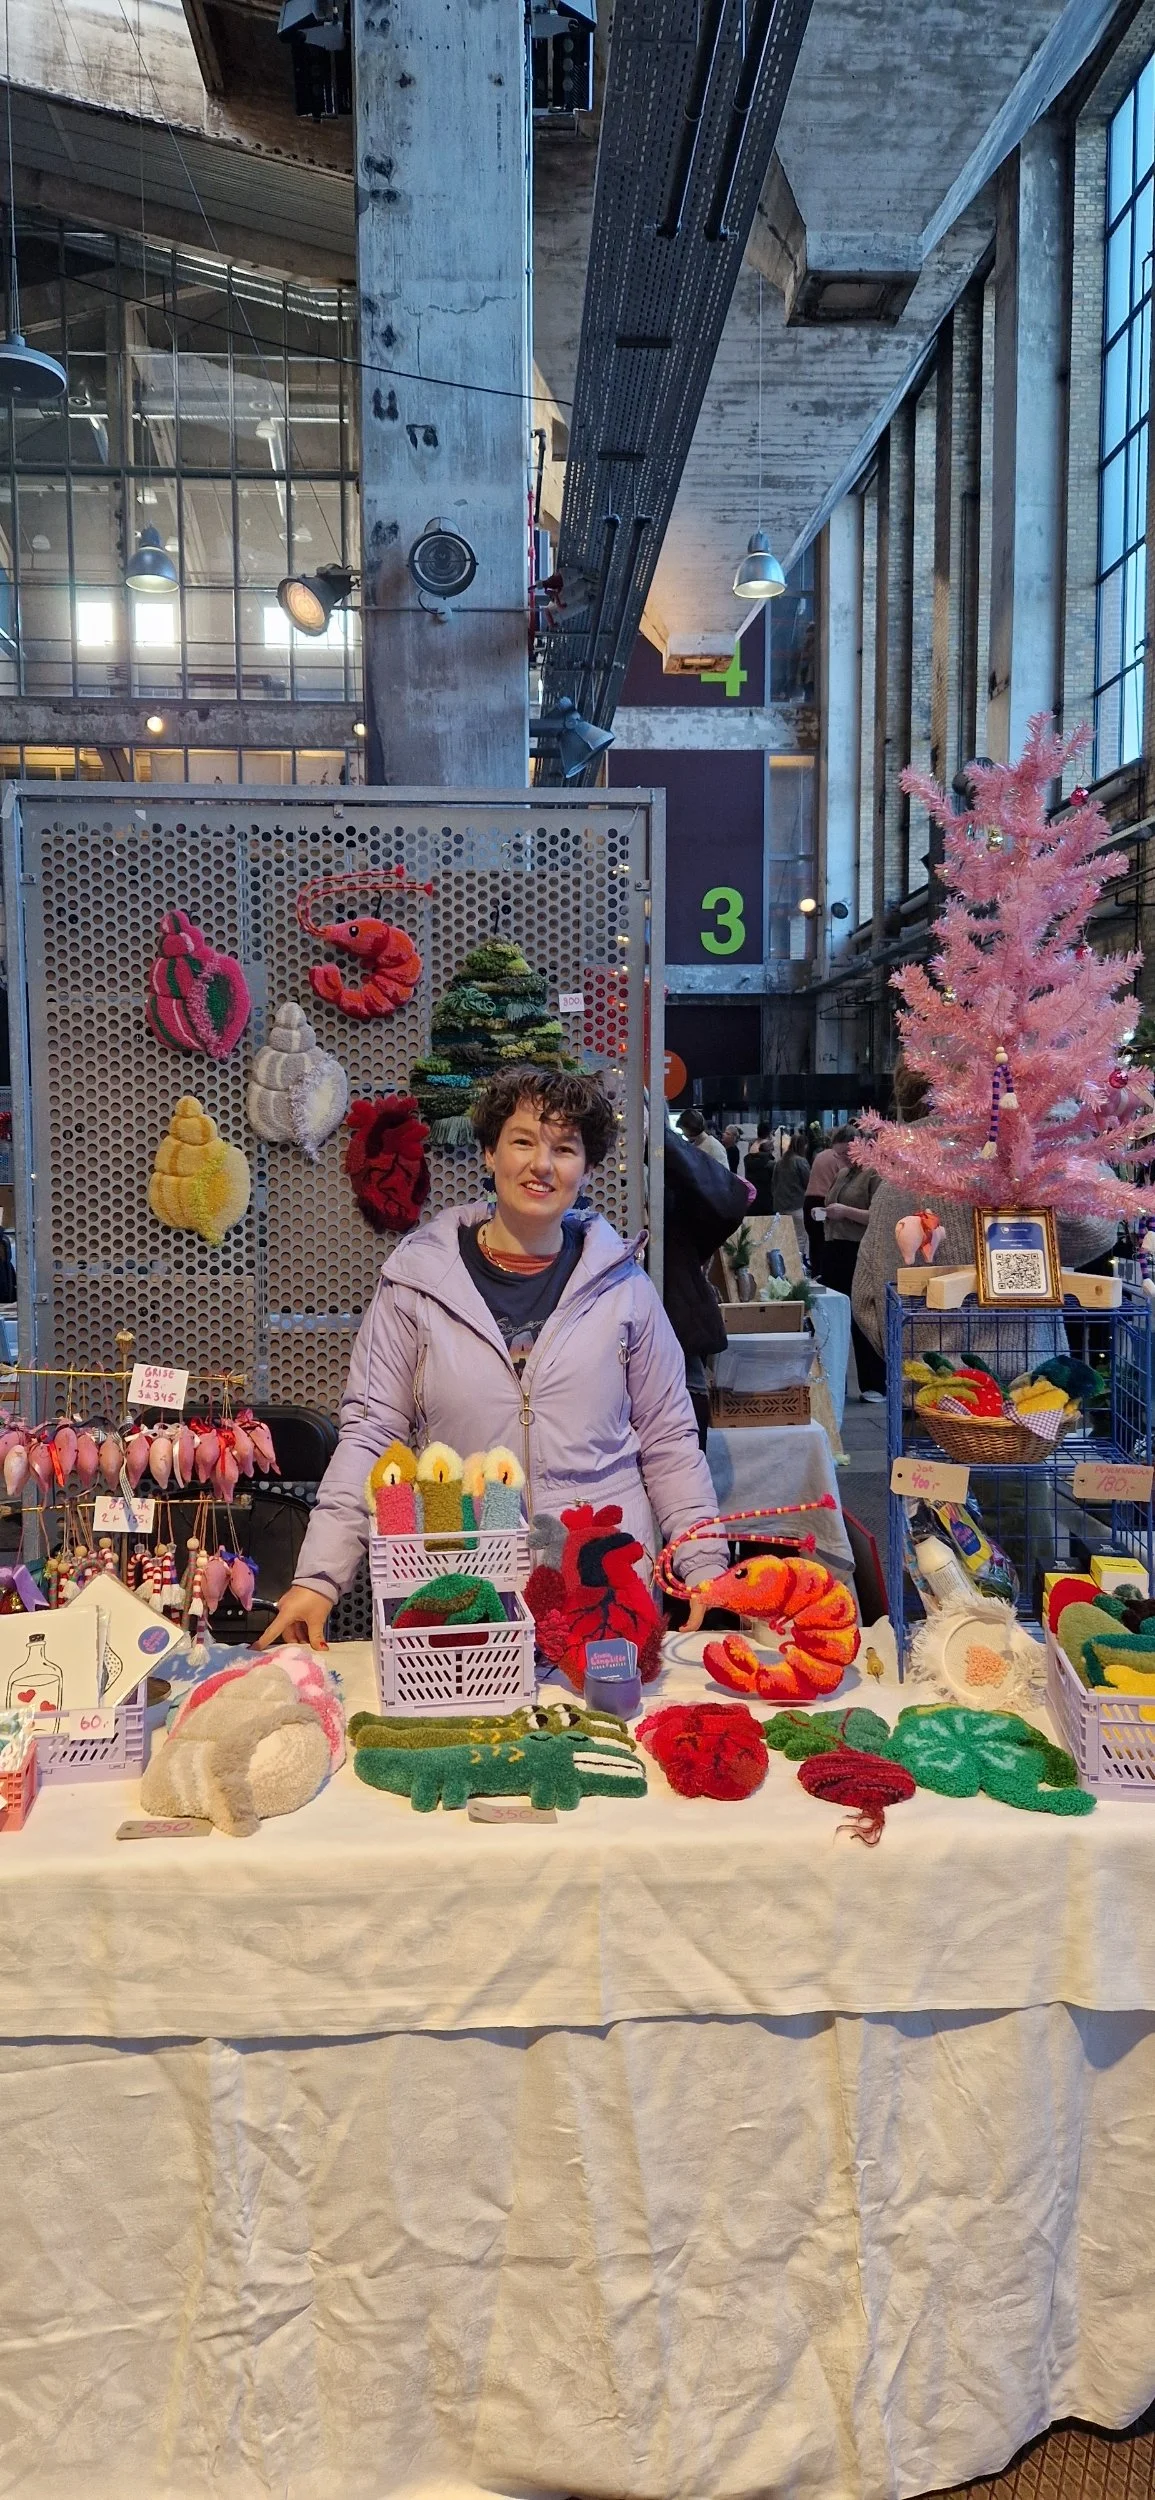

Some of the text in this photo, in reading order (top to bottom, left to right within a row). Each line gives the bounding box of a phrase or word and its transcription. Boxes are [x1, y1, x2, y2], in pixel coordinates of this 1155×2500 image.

[700, 638, 748, 697] 4
[700, 886, 746, 955] 3
[144, 1367, 175, 1379] GRISE
